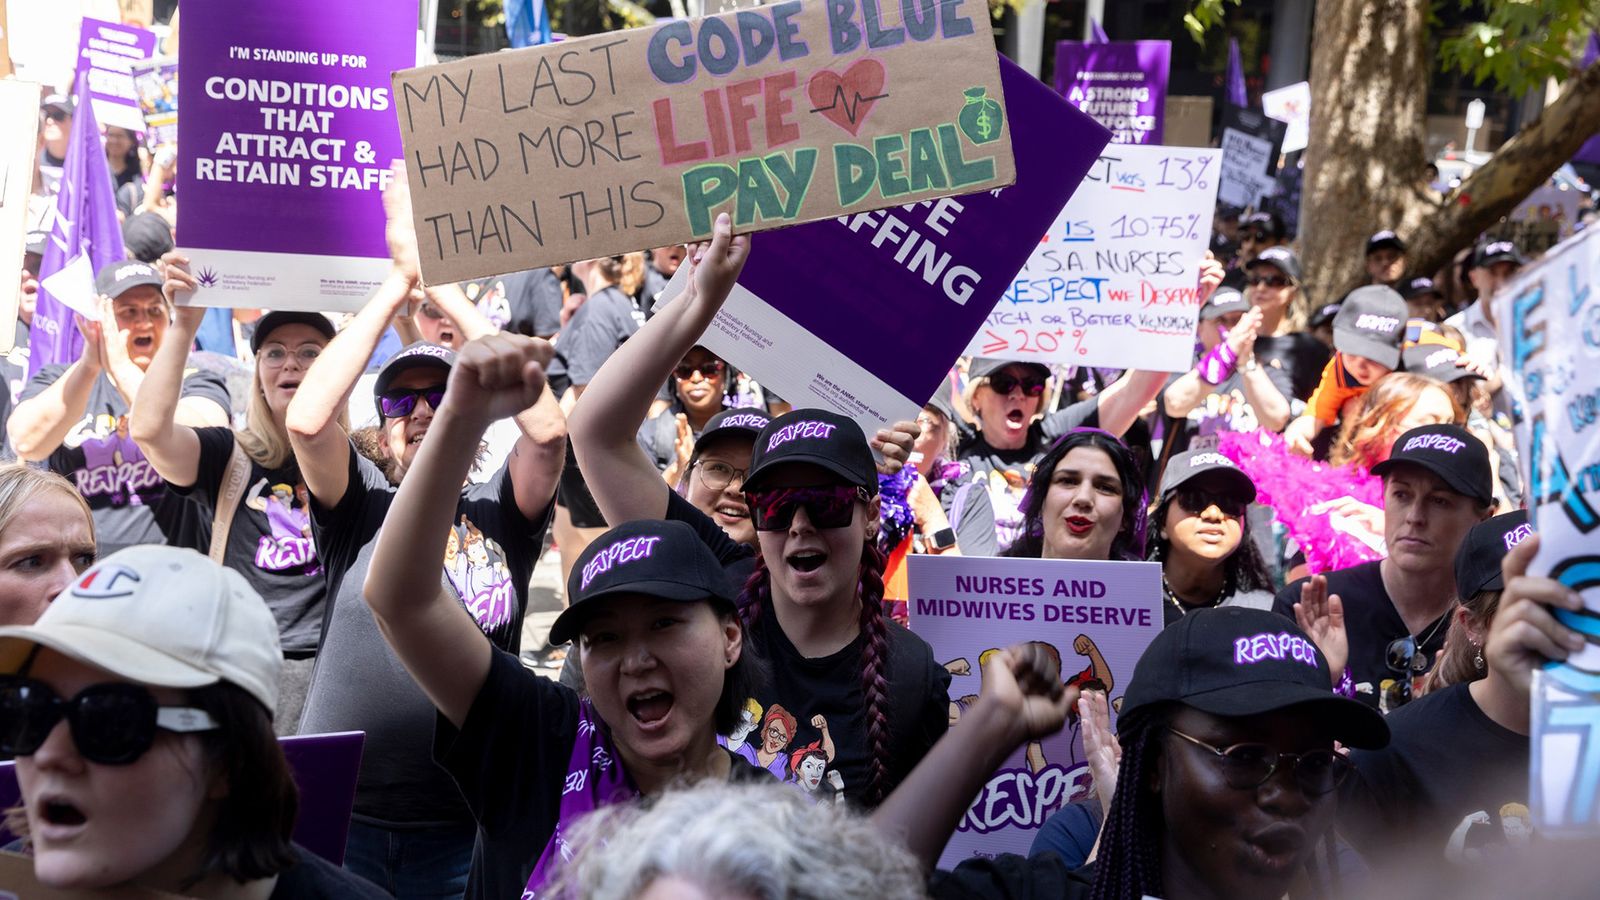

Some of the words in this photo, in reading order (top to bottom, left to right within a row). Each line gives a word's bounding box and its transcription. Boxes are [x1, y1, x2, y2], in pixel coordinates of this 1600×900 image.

[229, 46, 251, 60] I'M
[253, 48, 318, 66] STANDING
[321, 52, 339, 66] UP
[341, 53, 367, 68] FOR
[402, 69, 474, 133] MY
[498, 39, 629, 116] LAST
[647, 4, 811, 85] CODE
[825, 0, 976, 56] BLUE
[204, 76, 389, 111] CONDITIONS
[260, 108, 334, 134] THAT
[415, 137, 500, 189] HAD
[518, 111, 642, 175] MORE
[650, 68, 800, 167] LIFE
[215, 132, 346, 162] ATTRACT
[353, 140, 376, 164] &
[196, 158, 300, 186] RETAIN
[310, 165, 395, 191] STAFF
[1156, 156, 1213, 191] 13%
[424, 200, 545, 262] THAN
[559, 180, 666, 242] THIS
[681, 147, 819, 238] PAY
[832, 122, 996, 209] DEAL
[1065, 219, 1095, 237] IS
[837, 209, 982, 306] FFING
[1096, 249, 1185, 277] NURSES
[719, 308, 744, 328] Australian
[743, 324, 763, 341] Nursing
[762, 337, 773, 348] and
[1068, 307, 1137, 328] BETTER
[855, 398, 870, 412] stand
[766, 421, 838, 454] RESPECT
[1403, 433, 1466, 454] RESPECT
[75, 460, 163, 496] RESPEC
[580, 535, 661, 592] RESPECT
[955, 575, 1045, 596] NURSES
[1052, 579, 1107, 599] AND
[916, 598, 1035, 621] MIDWIVES
[1043, 604, 1152, 627] DESERVE
[1233, 632, 1320, 670] RESPECT
